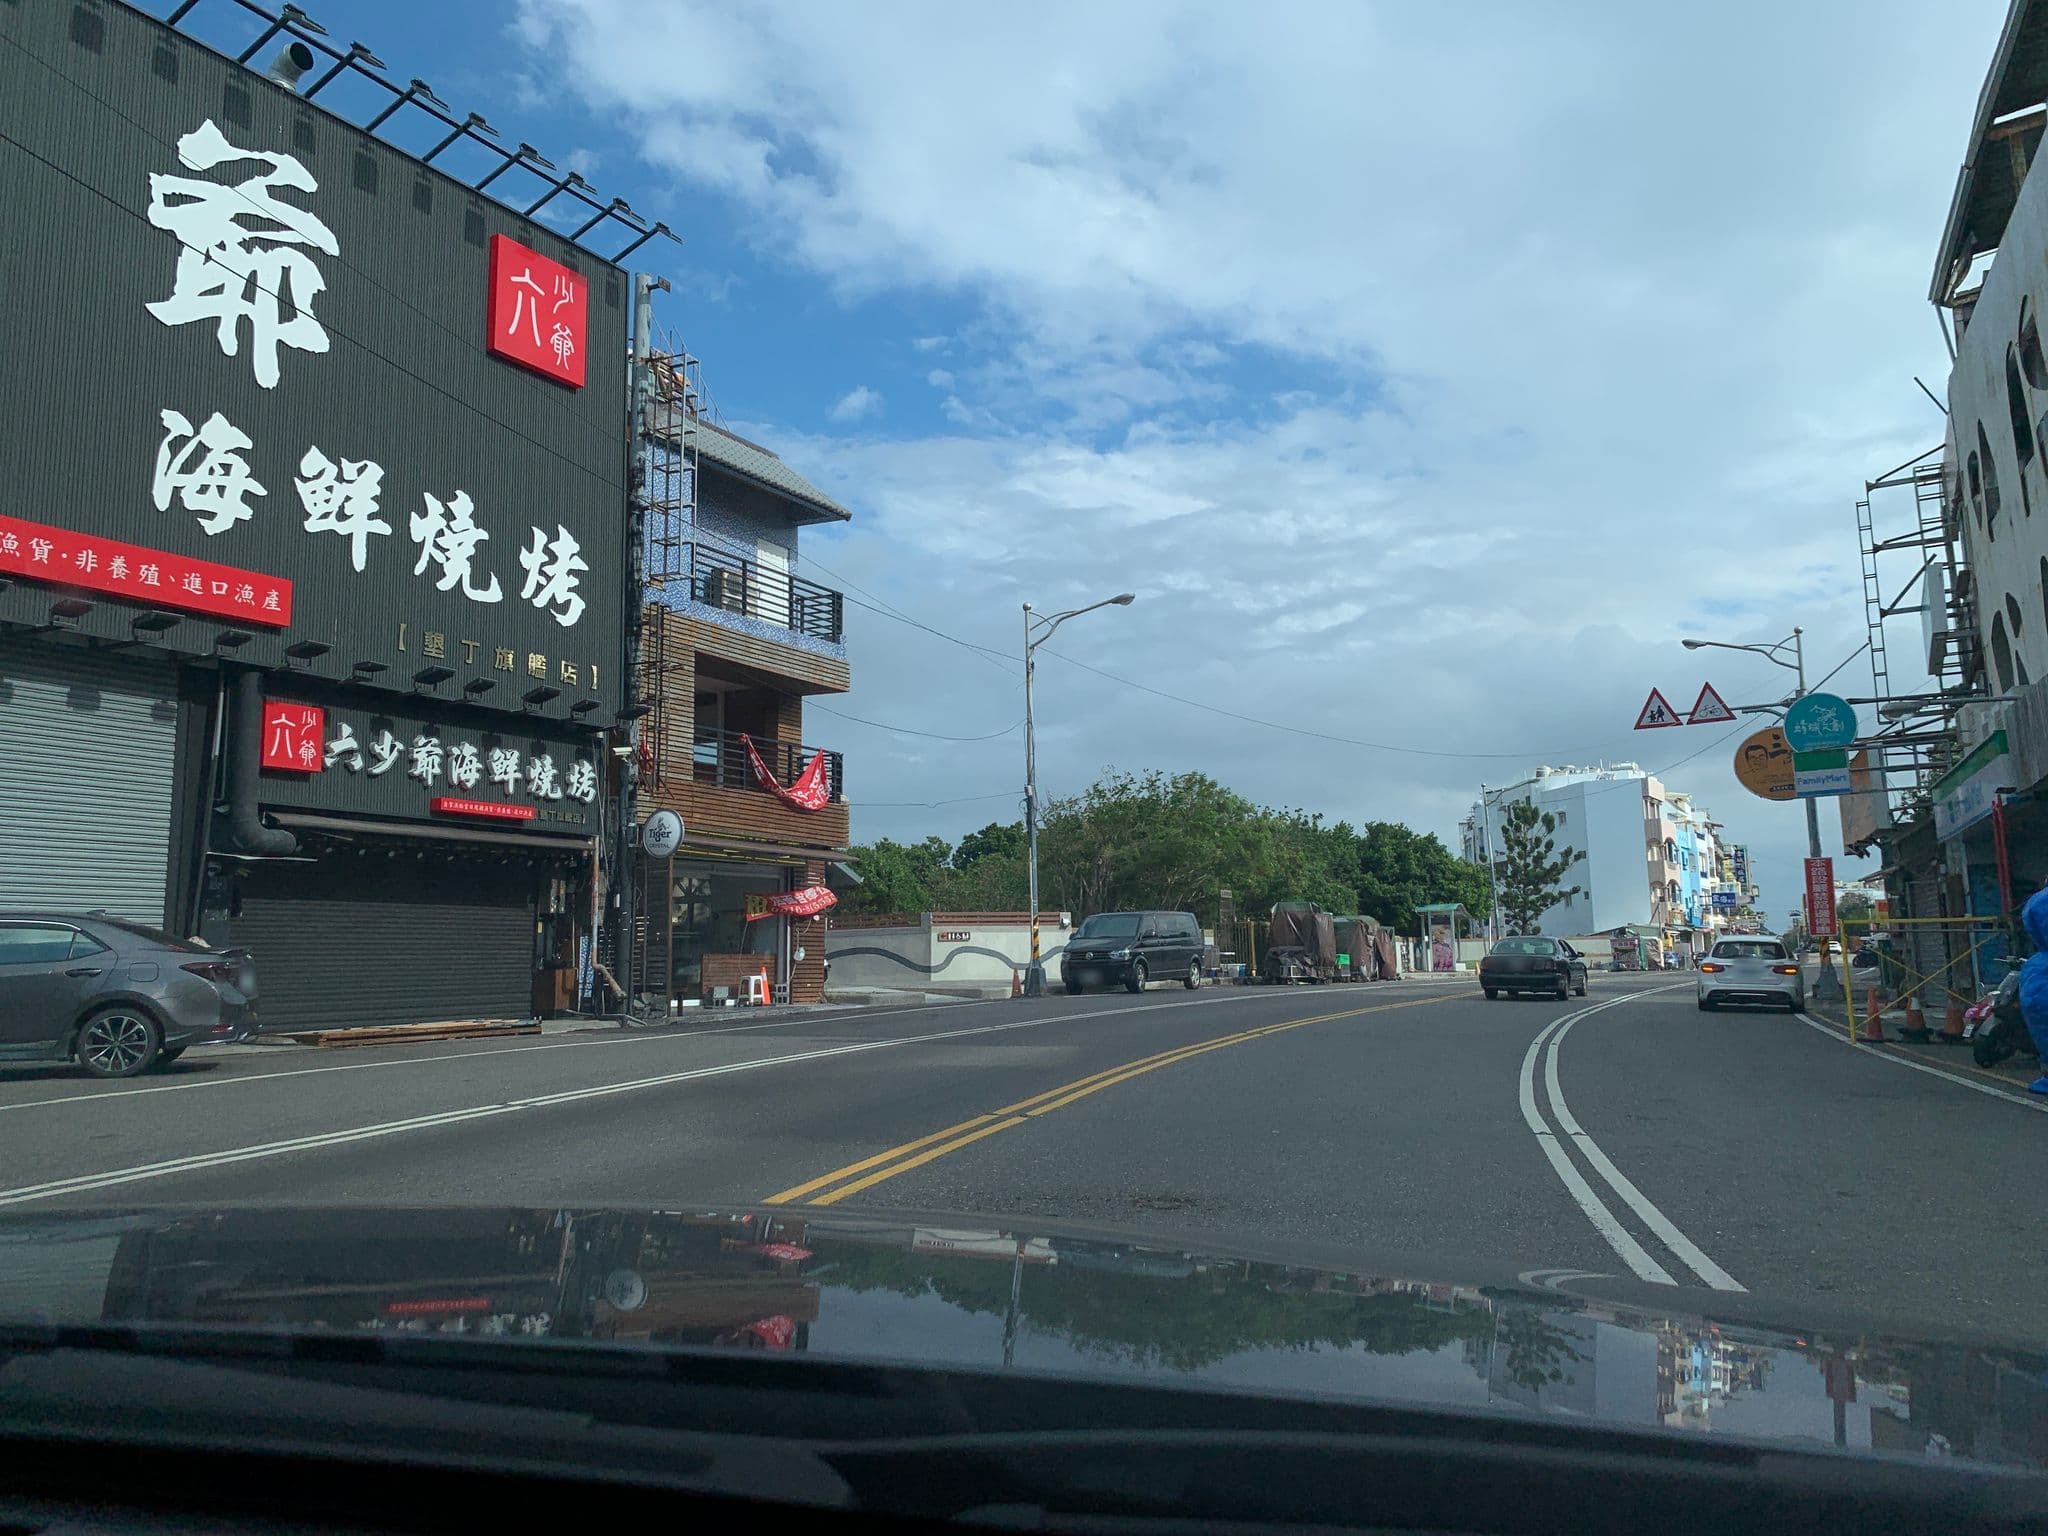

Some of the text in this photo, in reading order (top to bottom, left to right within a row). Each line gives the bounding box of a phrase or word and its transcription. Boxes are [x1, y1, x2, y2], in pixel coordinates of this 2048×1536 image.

[145, 118, 340, 390] 爺
[509, 268, 545, 347] 六
[152, 408, 590, 627] 海鮮燒烤
[323, 722, 598, 803] 六少爺海鮮燒烤
[1797, 774, 1847, 785] FamilyMart
[649, 827, 672, 842] Tiger
